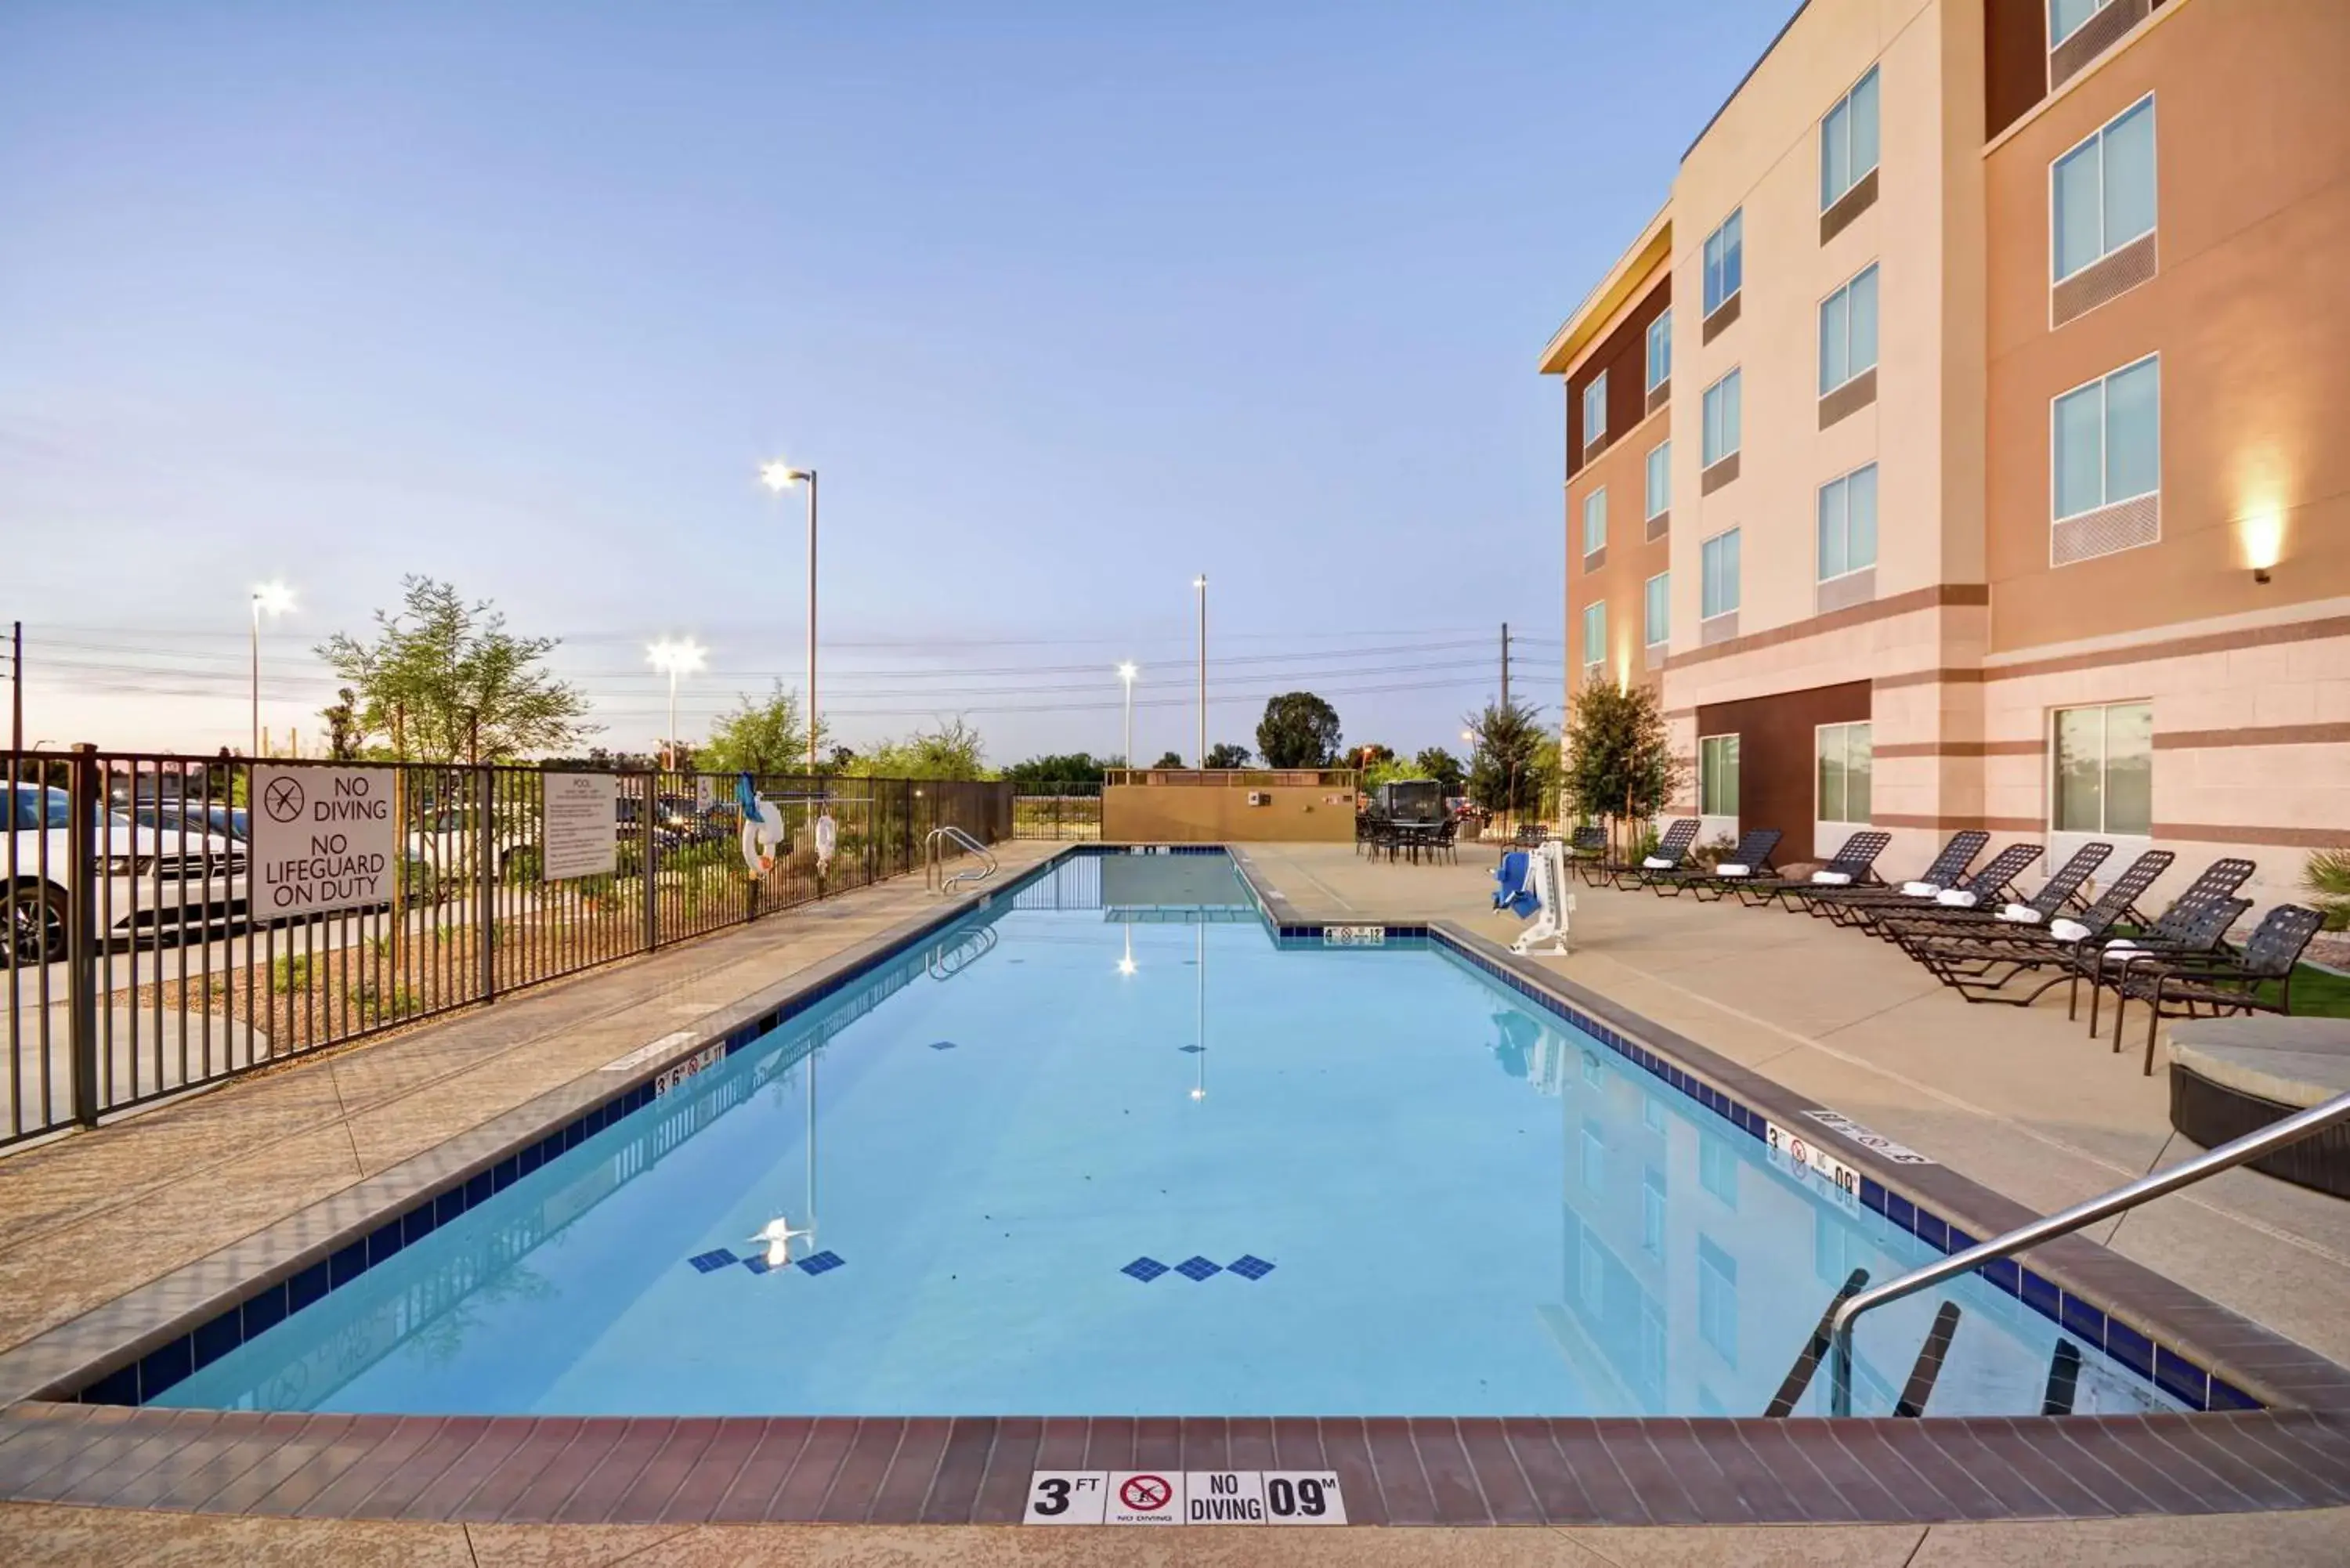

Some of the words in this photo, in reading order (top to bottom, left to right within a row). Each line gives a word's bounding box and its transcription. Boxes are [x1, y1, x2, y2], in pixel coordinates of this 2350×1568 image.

[334, 777, 369, 796] NO
[315, 800, 387, 822] DIVING
[312, 834, 347, 855] NO
[266, 854, 385, 883] LIFEGUARD
[274, 883, 313, 907] ON
[321, 876, 378, 901] DUTY
[1210, 1474, 1238, 1494] NO
[1034, 1478, 1071, 1516] 3
[1076, 1478, 1100, 1491] FT
[1268, 1478, 1326, 1516] 0.9
[1321, 1478, 1336, 1489] M
[1191, 1498, 1261, 1520] DIVING
